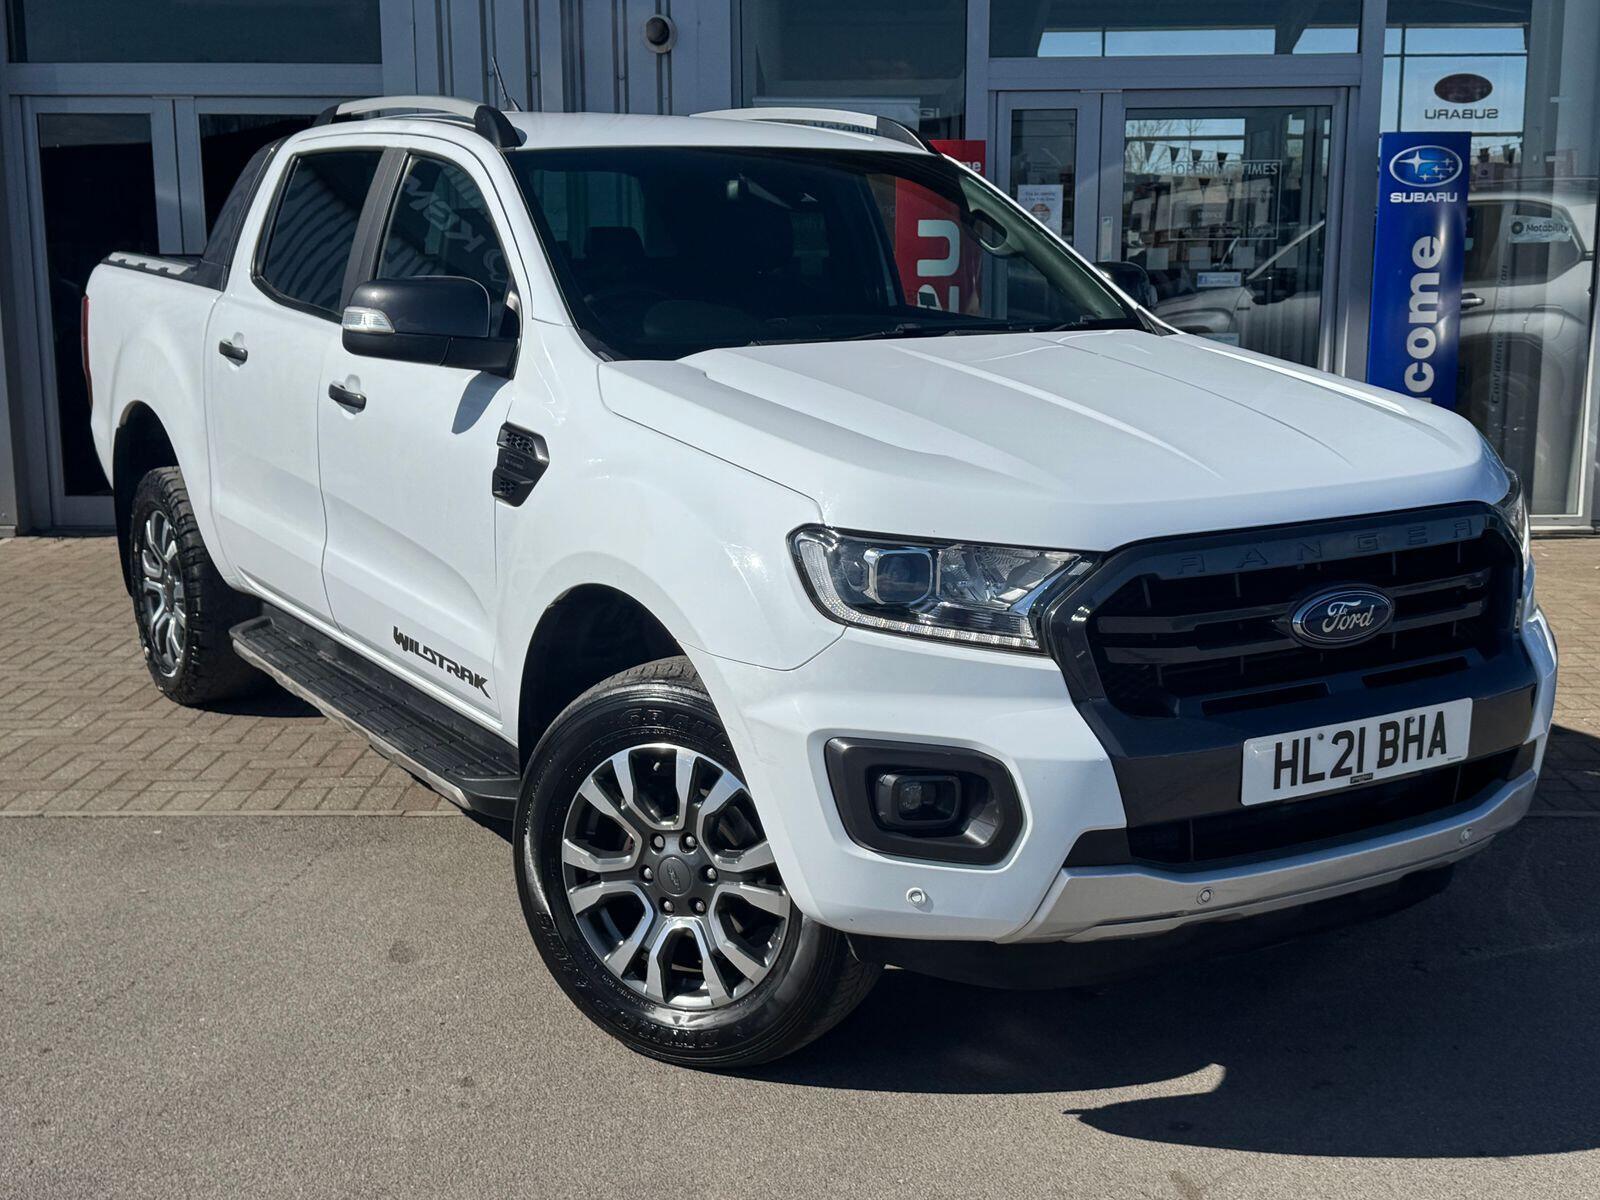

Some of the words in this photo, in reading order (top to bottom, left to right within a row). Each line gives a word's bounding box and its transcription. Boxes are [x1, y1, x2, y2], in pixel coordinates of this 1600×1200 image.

[1241, 163, 1279, 175] TIMES
[1390, 191, 1458, 203] SUBARU
[1403, 235, 1443, 404] come
[1176, 516, 1473, 575] RANGER
[1321, 599, 1376, 633] Ford
[393, 625, 492, 700] WILDTRAK
[1273, 726, 1366, 790] HL21
[1376, 710, 1447, 769] BHA
